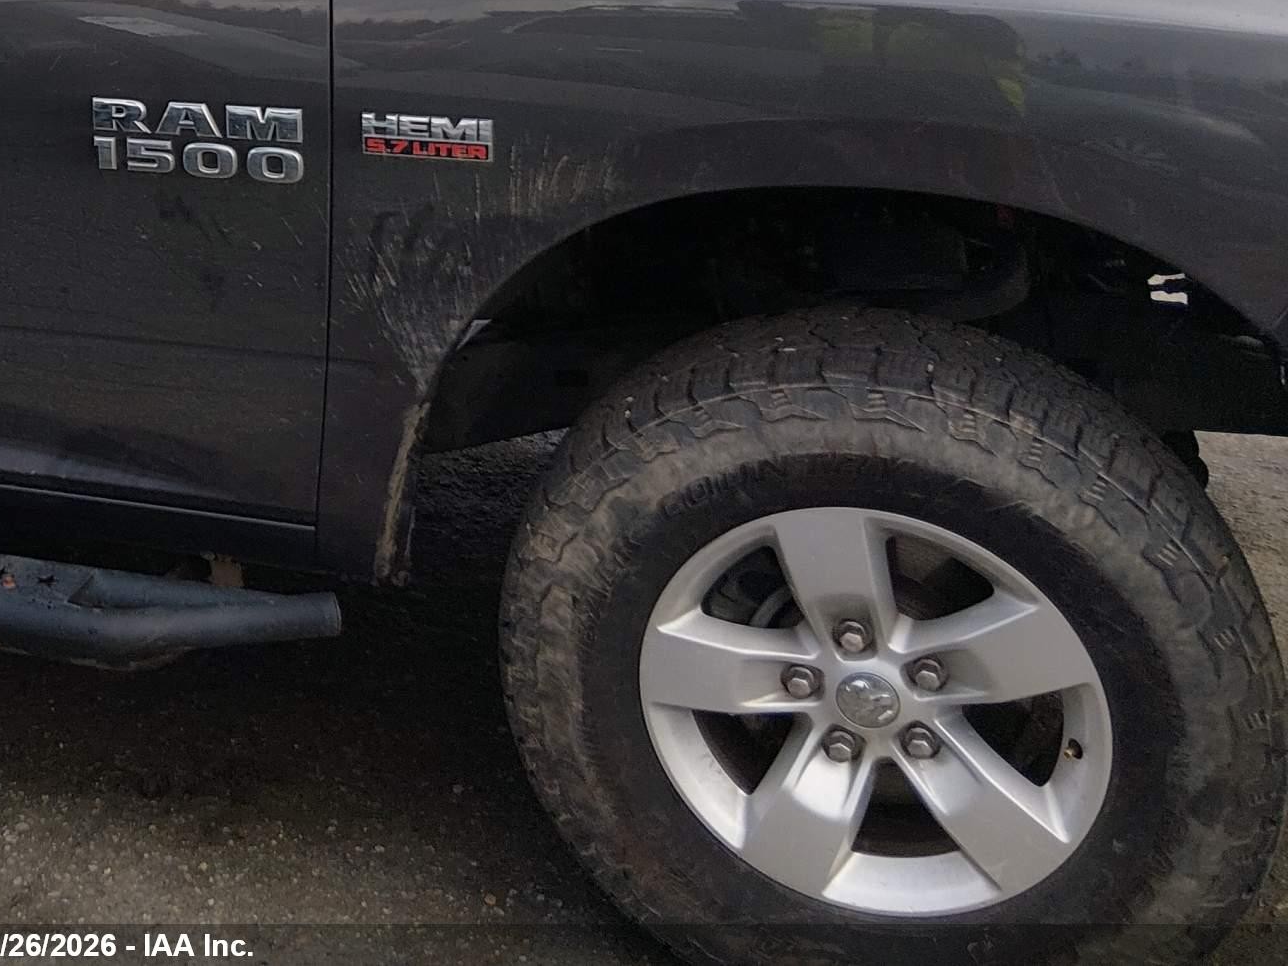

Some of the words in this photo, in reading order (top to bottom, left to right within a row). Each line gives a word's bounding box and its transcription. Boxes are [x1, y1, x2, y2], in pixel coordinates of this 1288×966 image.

[92, 97, 303, 143] RAM
[361, 112, 494, 143] HEMI
[94, 136, 304, 184] 1500
[365, 137, 408, 154] 5.7
[412, 142, 487, 160] LITER
